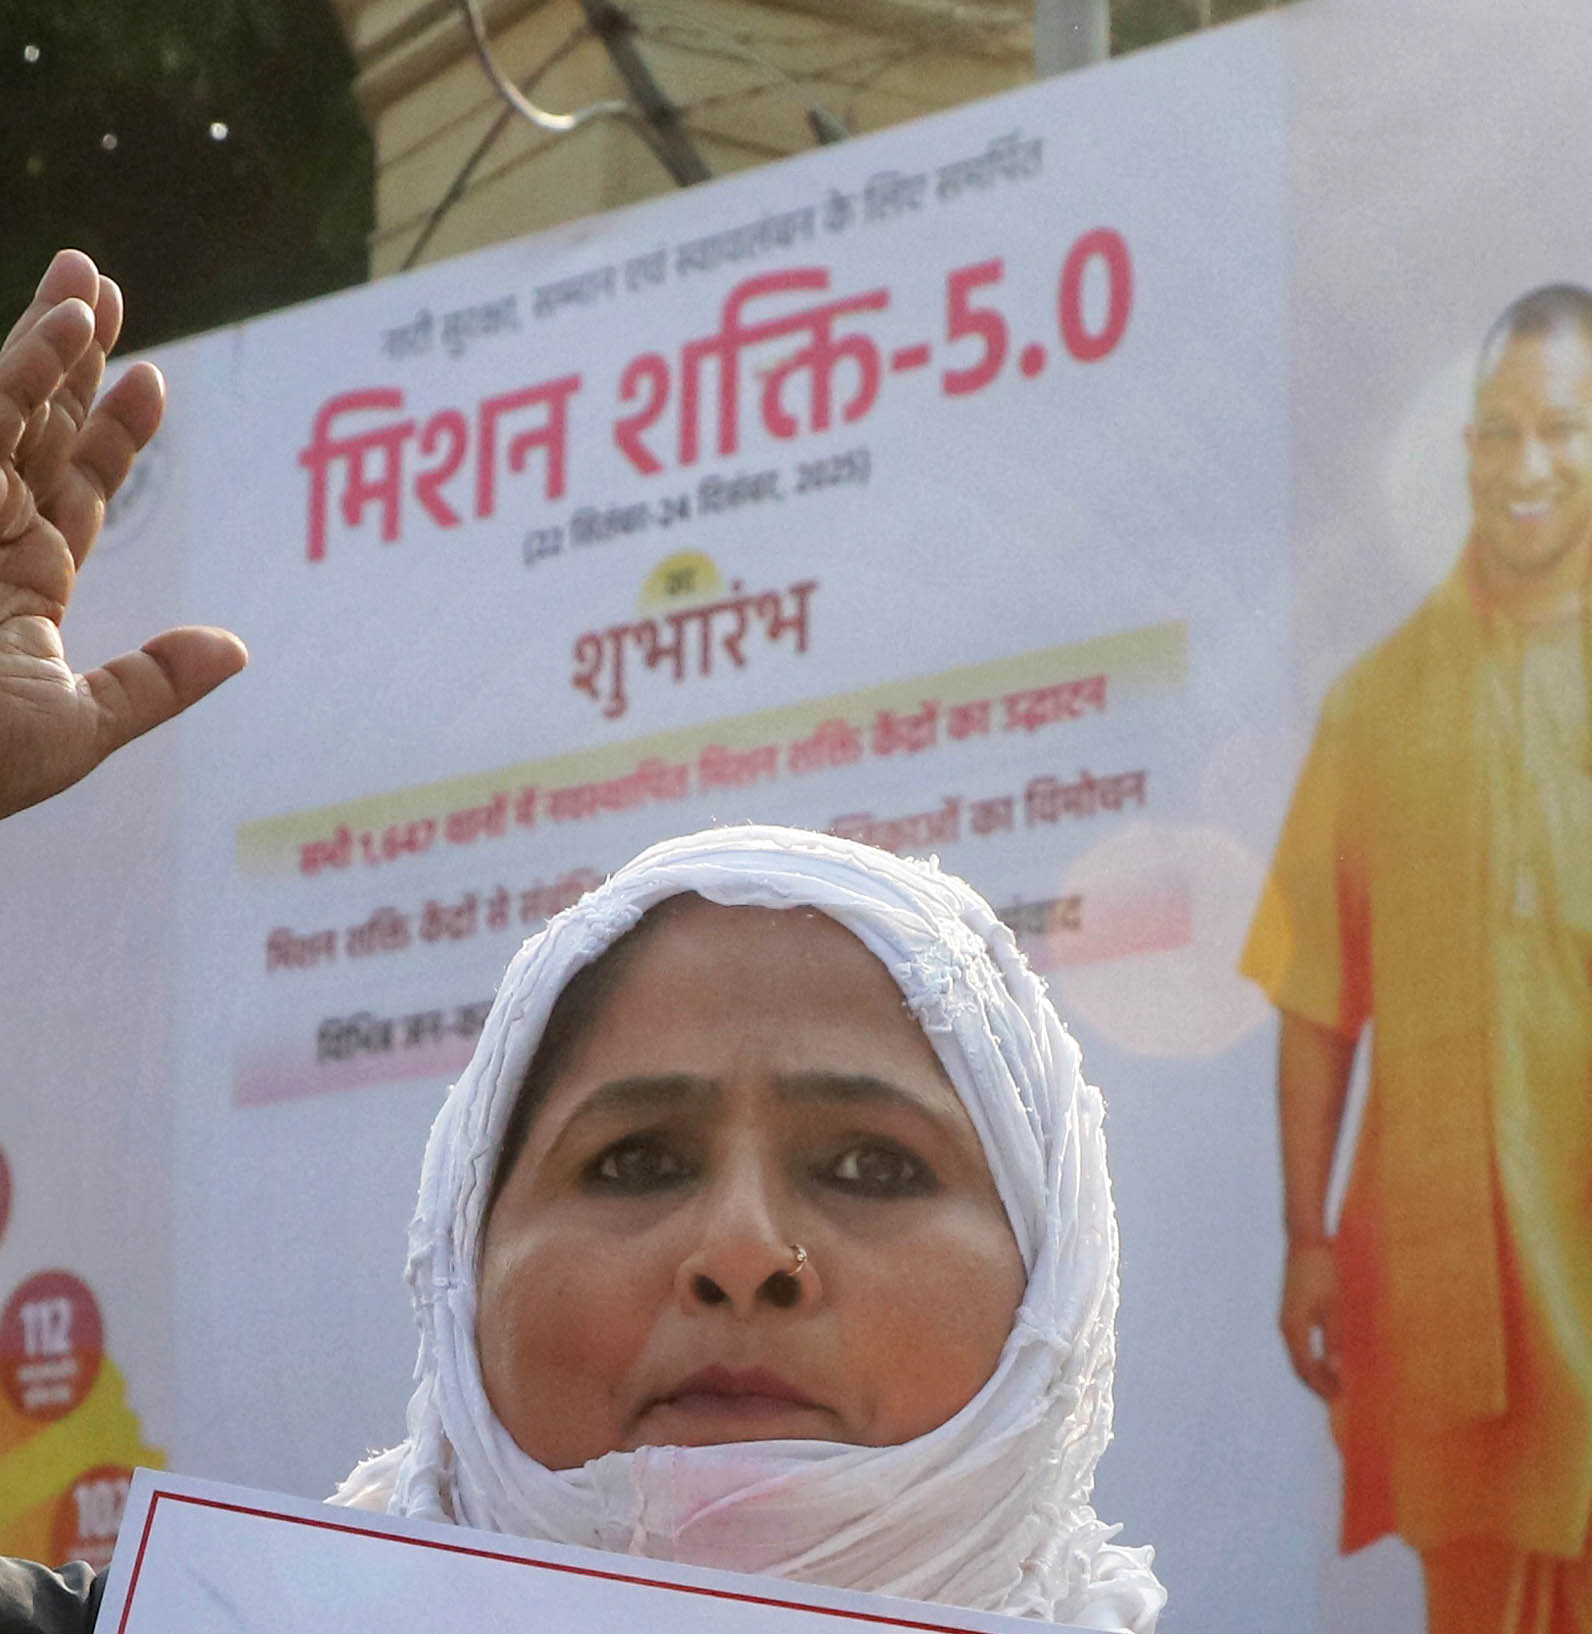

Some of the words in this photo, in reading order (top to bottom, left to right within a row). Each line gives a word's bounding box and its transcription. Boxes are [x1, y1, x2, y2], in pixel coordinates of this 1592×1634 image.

[298, 376, 582, 562] मिशन
[613, 228, 1133, 478] शक्ति-5.0
[571, 578, 818, 720] शुभारंभ
[948, 700, 991, 740] का
[970, 795, 1013, 836] का
